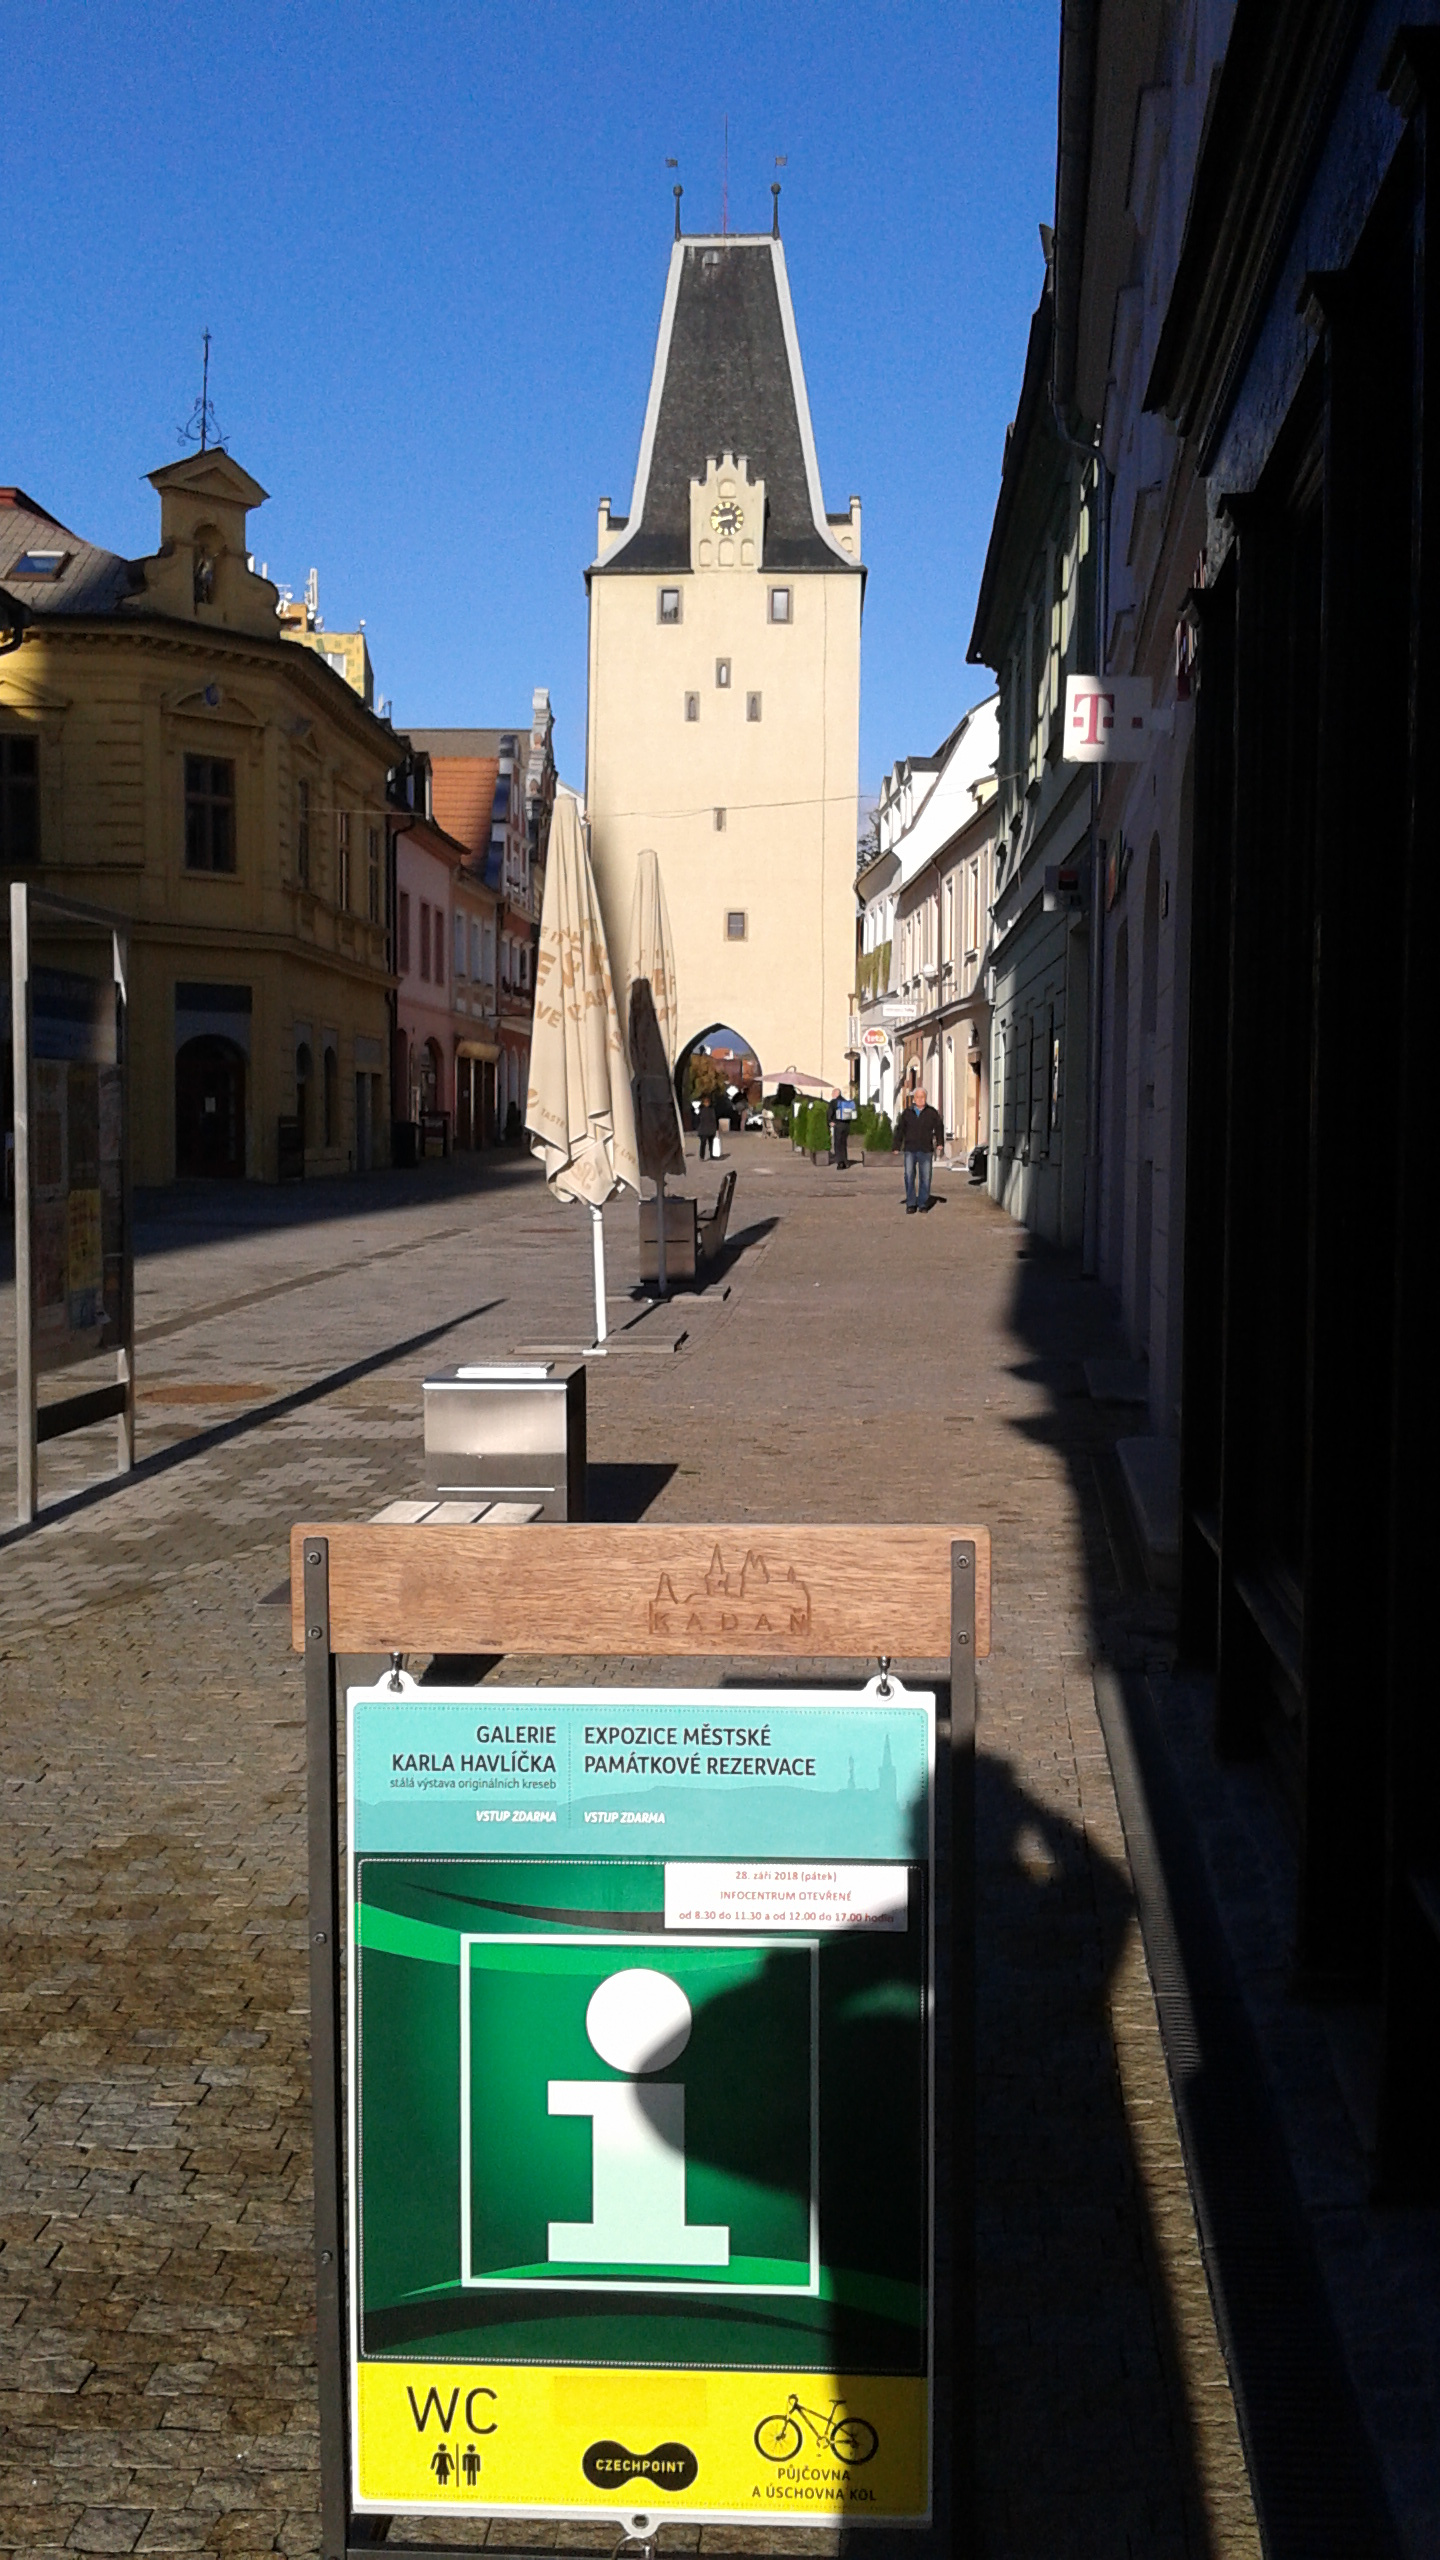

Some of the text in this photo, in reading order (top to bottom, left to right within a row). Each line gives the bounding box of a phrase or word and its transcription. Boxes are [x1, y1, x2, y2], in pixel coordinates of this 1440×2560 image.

[476, 1725, 557, 1744] GALERIE
[583, 1723, 772, 1746] EXPOZICE MĚSTSKÉ
[392, 1750, 557, 1773] KARLA HAVLÍČKA
[583, 1752, 817, 1776] PAMÁTKOVÉ REZERVACE
[389, 1776, 557, 1791] stálá výstava originálních kreseb
[476, 1810, 557, 1824] VSTUP ZDARMA
[583, 1811, 666, 1824] VSTUP ZDARMA
[735, 1871, 838, 1883] 28. září 2018 (pátek)
[720, 1890, 852, 1902] INFOCENTRUM OTEVŘENÉ
[679, 1910, 895, 1923] od 8.30 do 11.30 a od 12.00 do 17.00 hodin
[406, 2385, 498, 2435] WC
[594, 2458, 686, 2473] CZECHPOINT
[777, 2464, 851, 2483] PŮJČOVNA
[751, 2483, 877, 2502] A ÚSCHOVNA KOL
